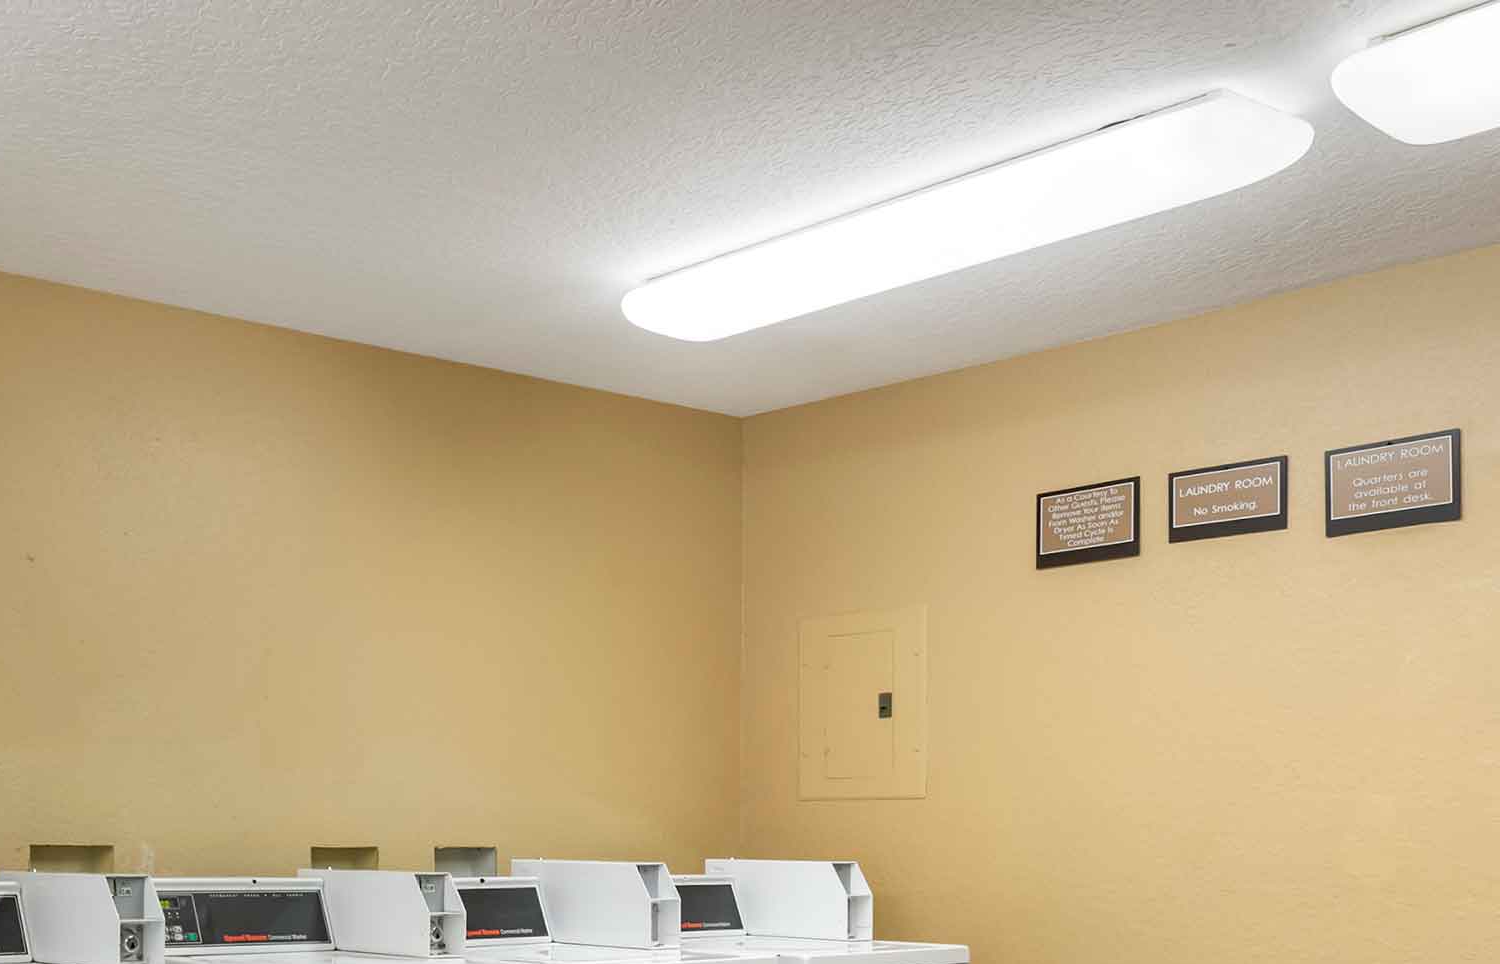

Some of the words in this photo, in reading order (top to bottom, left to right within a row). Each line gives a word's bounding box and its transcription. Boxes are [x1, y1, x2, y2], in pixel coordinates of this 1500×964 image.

[1337, 451, 1395, 470] LAUNDRY
[1401, 444, 1444, 459] ROOM
[1179, 481, 1230, 498] LAUNDRY
[1235, 475, 1273, 489] ROOM
[1353, 473, 1403, 487] Quarters
[1408, 468, 1428, 478] are
[1354, 483, 1408, 499] available
[1414, 480, 1426, 490] at
[1193, 507, 1208, 517] No
[1348, 502, 1366, 512] the
[1372, 497, 1398, 508] front
